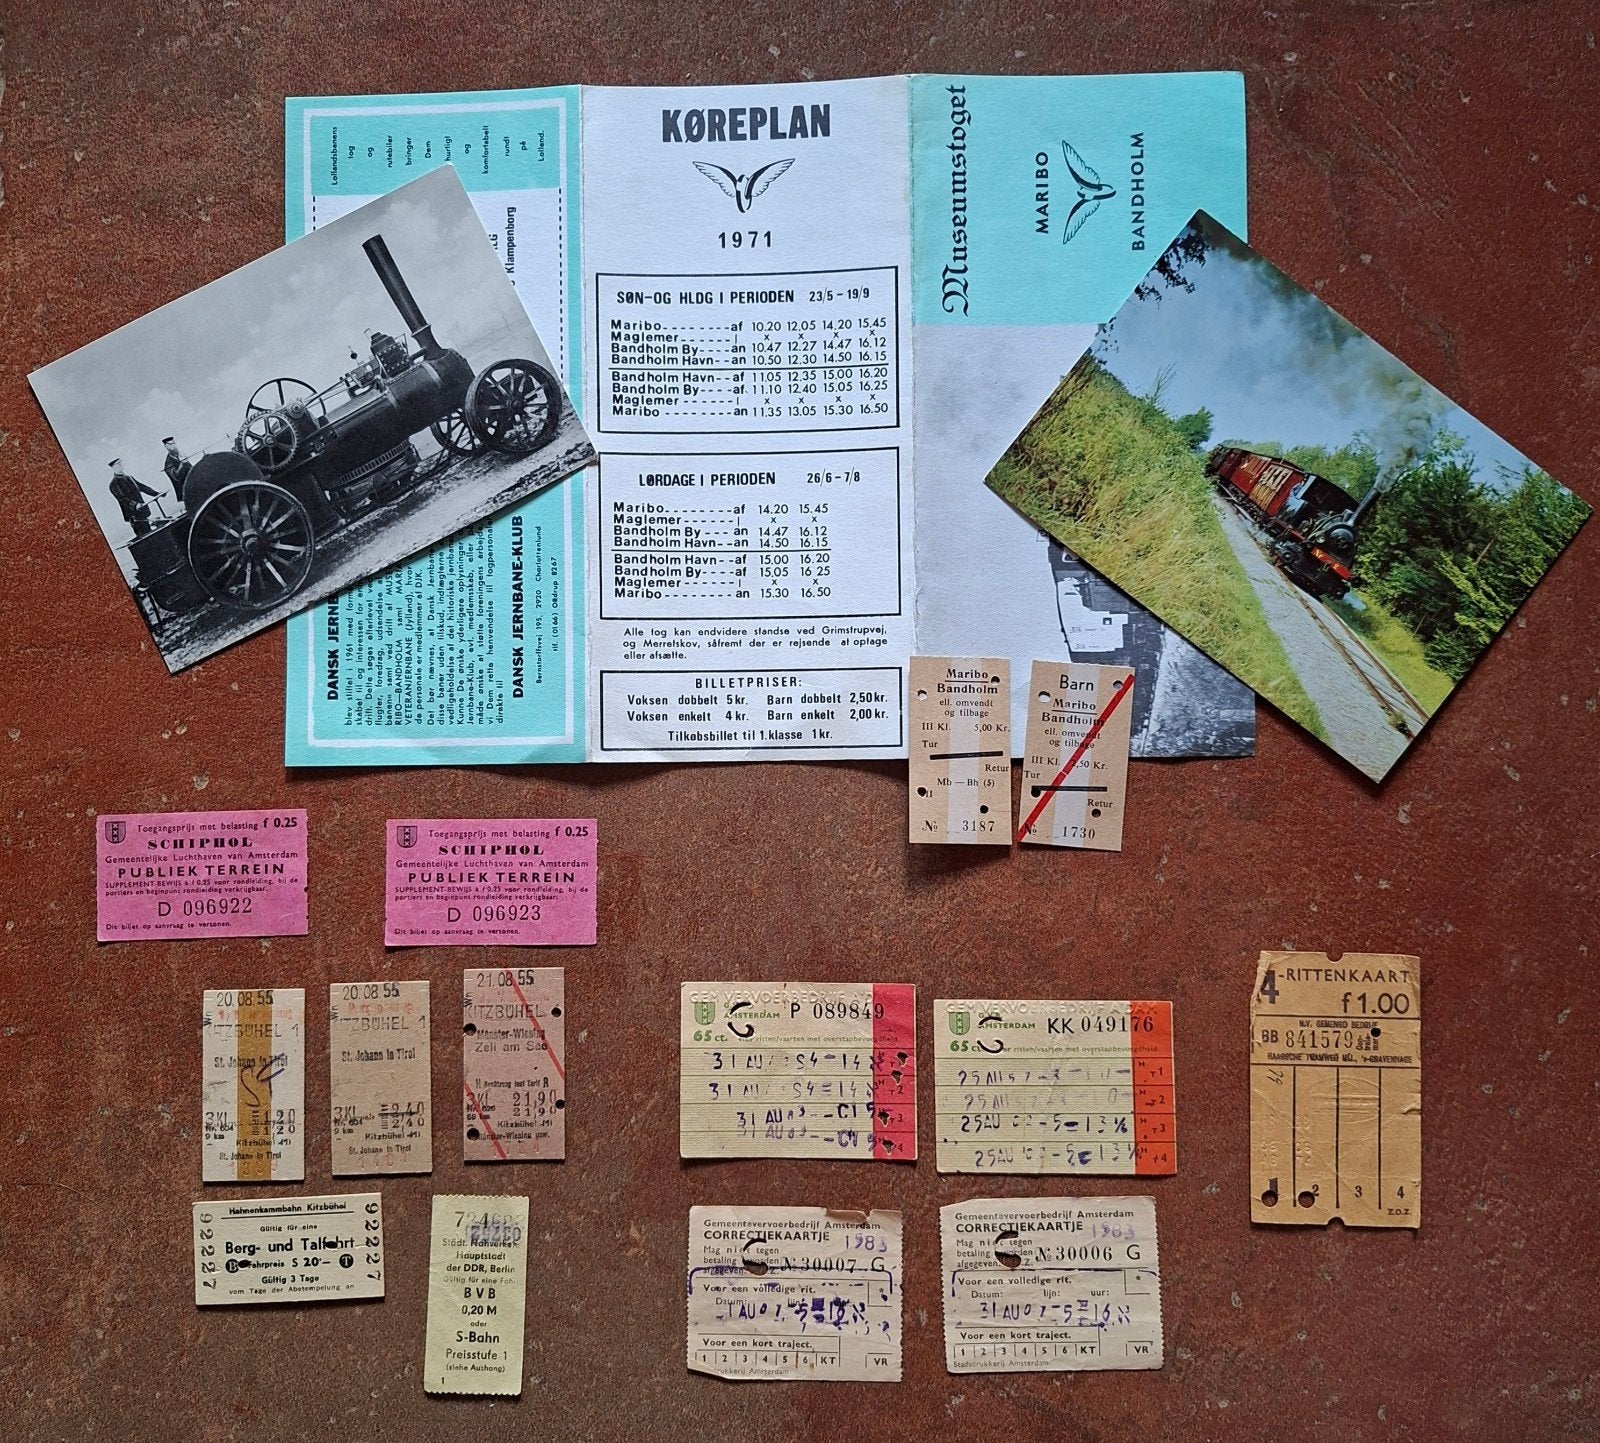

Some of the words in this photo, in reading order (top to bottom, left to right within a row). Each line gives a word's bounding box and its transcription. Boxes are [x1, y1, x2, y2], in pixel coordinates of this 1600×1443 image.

[662, 104, 830, 142] KØREPLAN
[1035, 152, 1048, 234] MARIBO
[1131, 132, 1145, 251] BANDHOLM
[941, 85, 971, 316] Museumstoget
[506, 207, 516, 273] Klampenborg
[718, 231, 772, 249] 1971
[680, 292, 713, 304] HLDG
[730, 290, 794, 304] PERIODEN
[611, 319, 662, 331] Maribo
[752, 321, 781, 332] 10.20
[787, 320, 816, 331] 12.05
[822, 319, 852, 330] 14.20
[858, 318, 886, 329] 15.45
[611, 332, 679, 344] Maglemer
[611, 343, 676, 354] Bandholm
[752, 342, 781, 353] 10.47
[788, 341, 817, 352] 12.27
[823, 339, 852, 350] 14.47
[859, 338, 886, 349] 16.12
[612, 371, 677, 383] Bandholm
[752, 372, 782, 383] 11.05
[788, 370, 816, 382] 12.35
[823, 369, 852, 380] 15.00
[859, 368, 887, 379] 16.20
[639, 475, 696, 487] LØRDAGE
[711, 472, 776, 486] PERIODEN
[614, 554, 681, 565] Bandholm
[759, 554, 789, 565] 15.00
[800, 553, 829, 564] 16.20
[512, 516, 523, 640] JERNBANE-KLUB
[614, 588, 662, 599] Maribo
[760, 587, 789, 599] 15.30
[801, 586, 831, 598] 16.50
[624, 627, 643, 636] Alle
[674, 628, 691, 636] kan
[698, 627, 747, 636] endvidere
[797, 626, 814, 635] ved
[328, 649, 338, 700] DANSK
[513, 646, 523, 698] DANSK
[946, 669, 988, 679] Maribo
[696, 677, 802, 689] BILLETPRISER:
[937, 684, 998, 694] Bandholm
[1060, 675, 1094, 691] Barn
[628, 695, 668, 706] Voksen
[678, 695, 718, 706] dobbelt
[767, 694, 793, 705] Barn
[801, 693, 841, 704] dobbelt
[956, 699, 993, 707] omvendt
[1053, 698, 1096, 711] Maribo
[627, 711, 668, 722] Voksen
[678, 712, 711, 722] enkelt
[768, 710, 793, 721] Barn
[801, 710, 834, 720] enkelt
[960, 709, 989, 717] tilbage
[922, 722, 933, 730] III
[974, 724, 992, 733] 5,00
[743, 730, 756, 741] til
[985, 764, 1009, 772] Retur
[937, 778, 952, 786] Mb
[967, 778, 978, 786] Bh
[1088, 799, 1113, 808] Retur
[137, 824, 195, 834] Toegangsprijs
[221, 822, 258, 831] belasting
[274, 817, 297, 828] 0.25
[962, 820, 995, 832] 3187
[1062, 826, 1095, 838] 1730
[148, 837, 253, 850] SCHIPHOL
[439, 845, 544, 855] SCHIPHOL
[105, 855, 168, 864] Gemeentelijke
[173, 853, 222, 861] Luchthaven
[248, 851, 298, 859] Amsterdam
[119, 866, 197, 878] PUBLIEK
[205, 864, 284, 875] TERREIN
[409, 873, 488, 883] PUBLIEK
[496, 873, 575, 882] TERREIN
[183, 898, 252, 916] 096922
[473, 905, 540, 921] 096923
[813, 1003, 884, 1019] 089849
[1081, 1016, 1154, 1033] 049176
[694, 1030, 712, 1042] 65
[1286, 1030, 1353, 1048] 841579
[225, 1242, 260, 1255] Berg-
[268, 1238, 293, 1252] und
[1056, 1246, 1112, 1261] 30006
[447, 1264, 460, 1272] der
[464, 1264, 487, 1272] DDR,
[491, 1264, 515, 1273] Berlin
[262, 1276, 286, 1285] Gültig
[300, 1275, 319, 1284] Tage
[462, 1305, 483, 1315] 0,20
[487, 1305, 496, 1315] M
[456, 1331, 499, 1343] S-Bahn
[961, 1332, 984, 1340] Voor
[1036, 1332, 1071, 1340] traject.
[446, 1349, 497, 1360] Preisstufe
[503, 1351, 507, 1360] 1
[1080, 1346, 1096, 1354] KT
